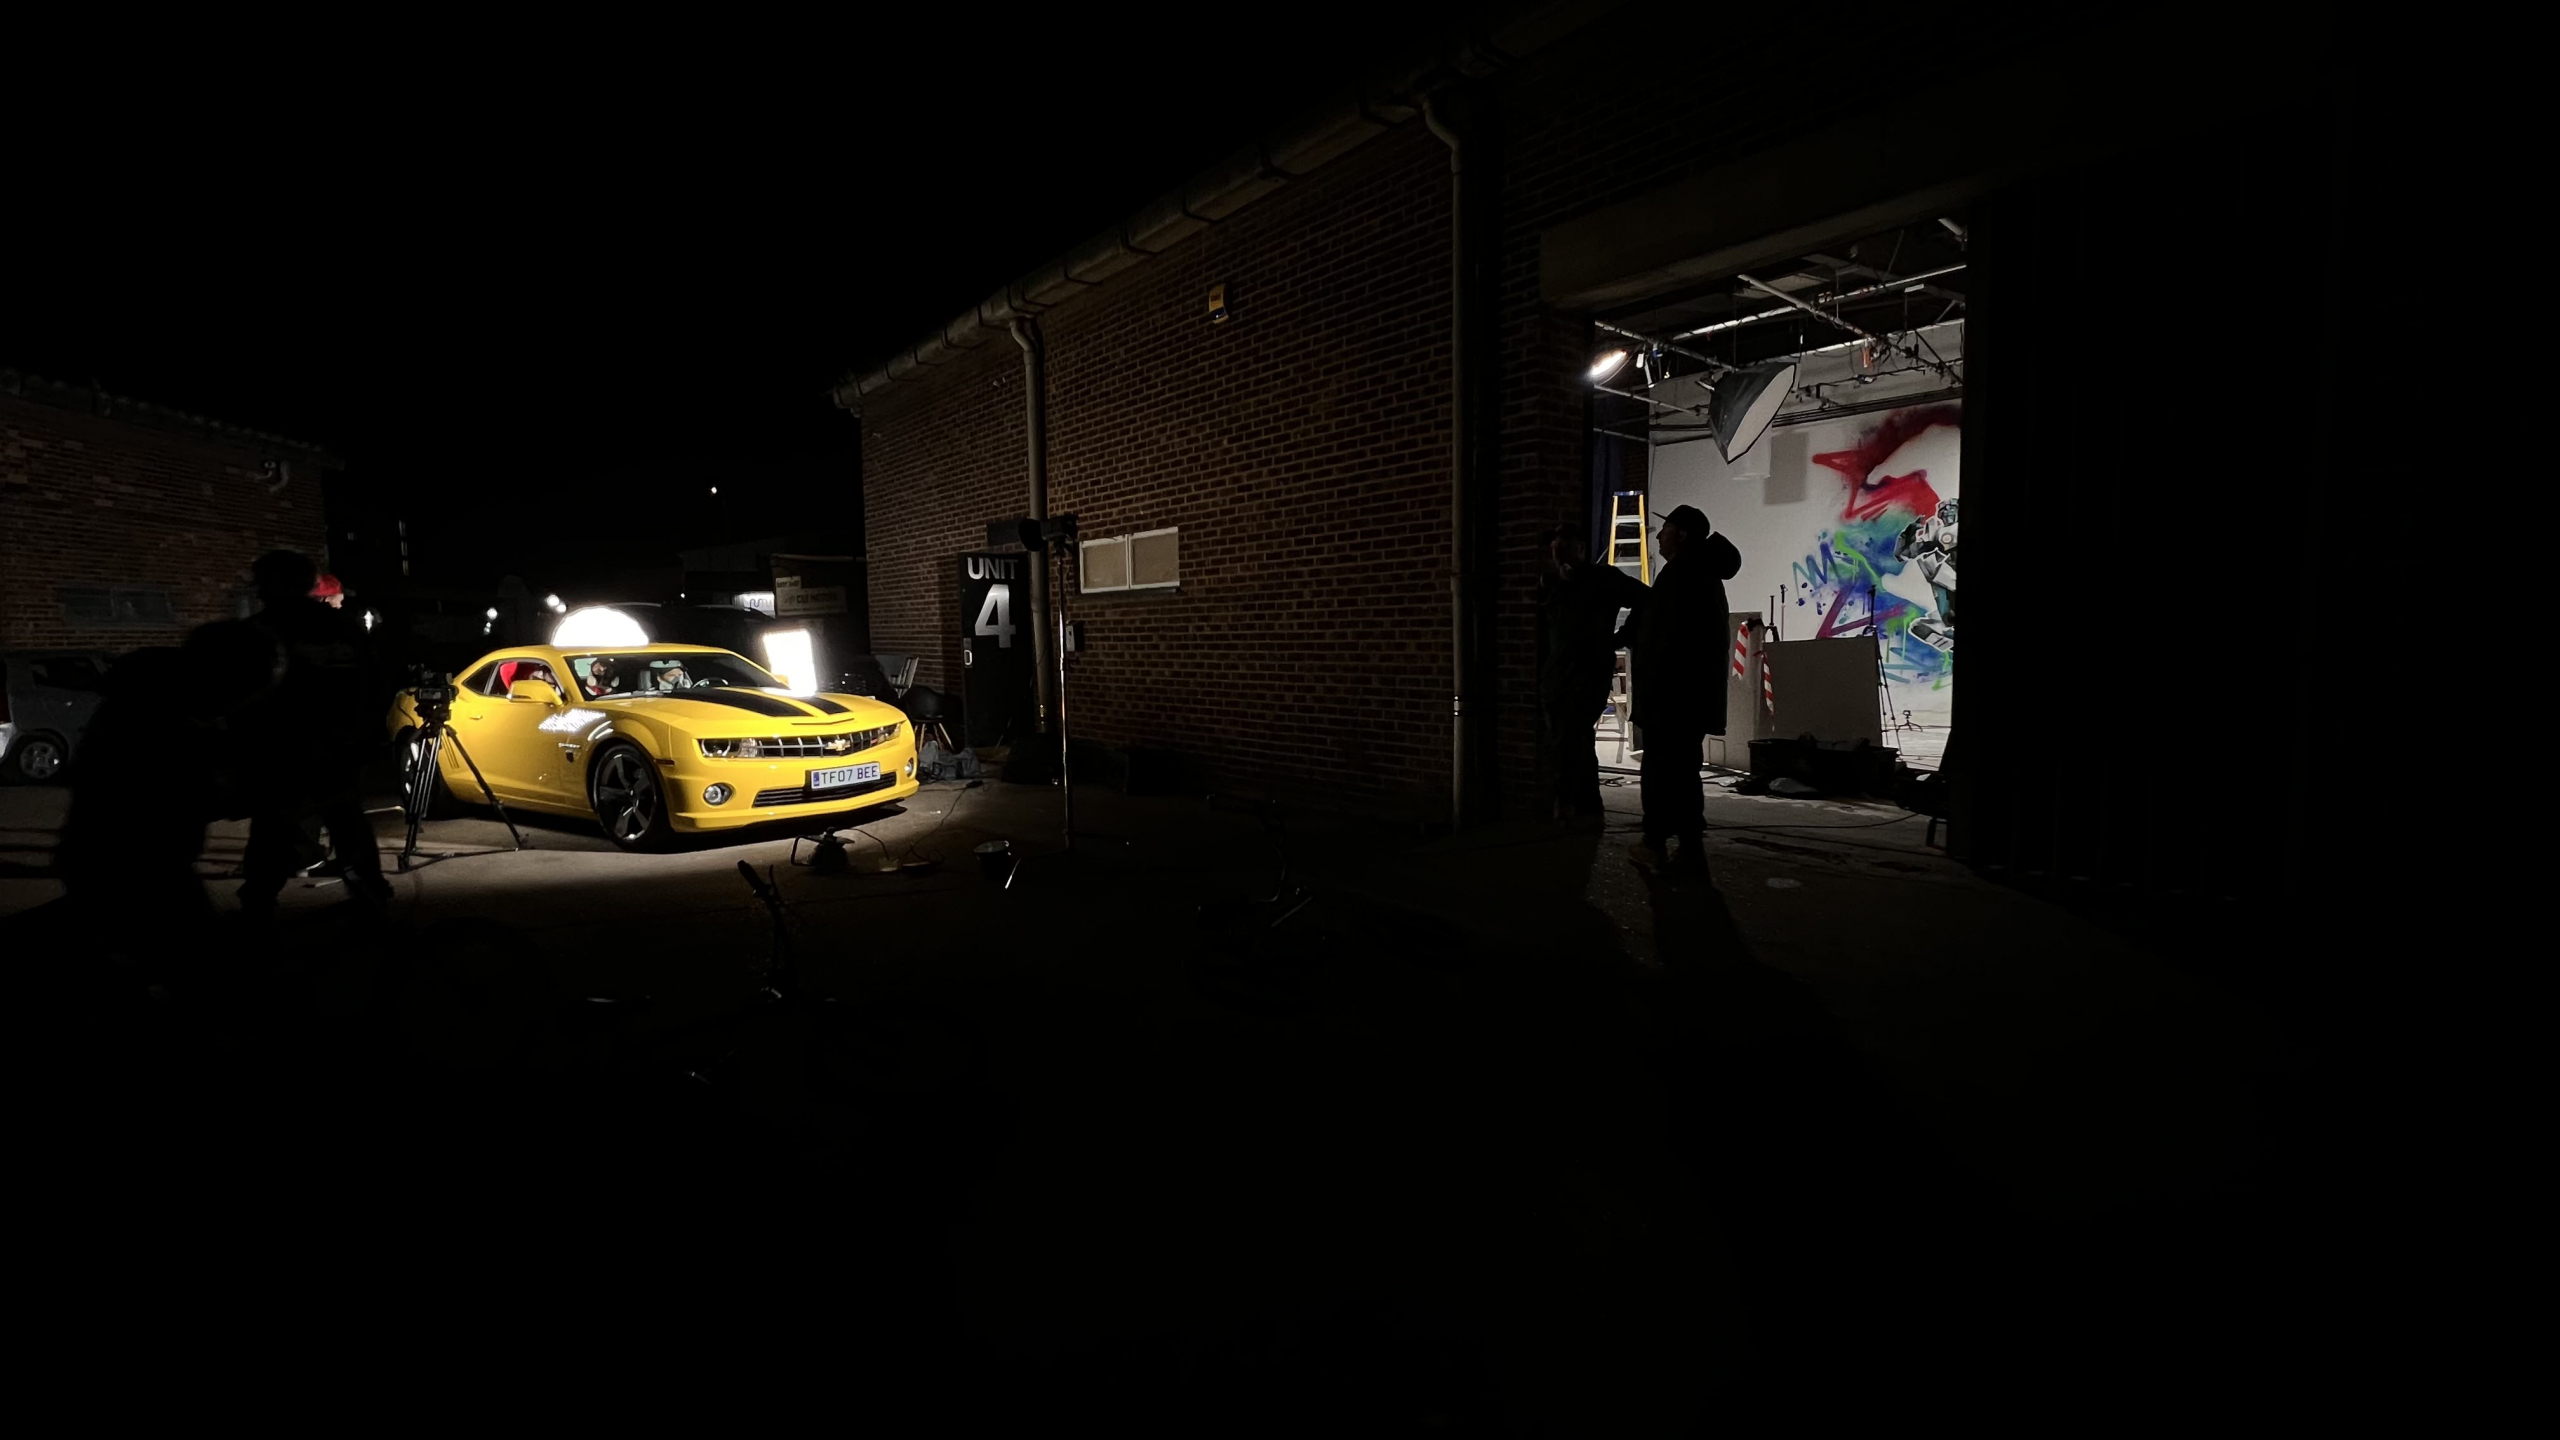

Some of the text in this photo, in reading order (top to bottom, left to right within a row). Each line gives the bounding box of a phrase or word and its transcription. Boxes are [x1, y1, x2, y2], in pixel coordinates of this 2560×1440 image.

[967, 556, 1018, 580] UNIT
[974, 583, 1016, 649] 4
[821, 765, 878, 785] TF07 BEE
